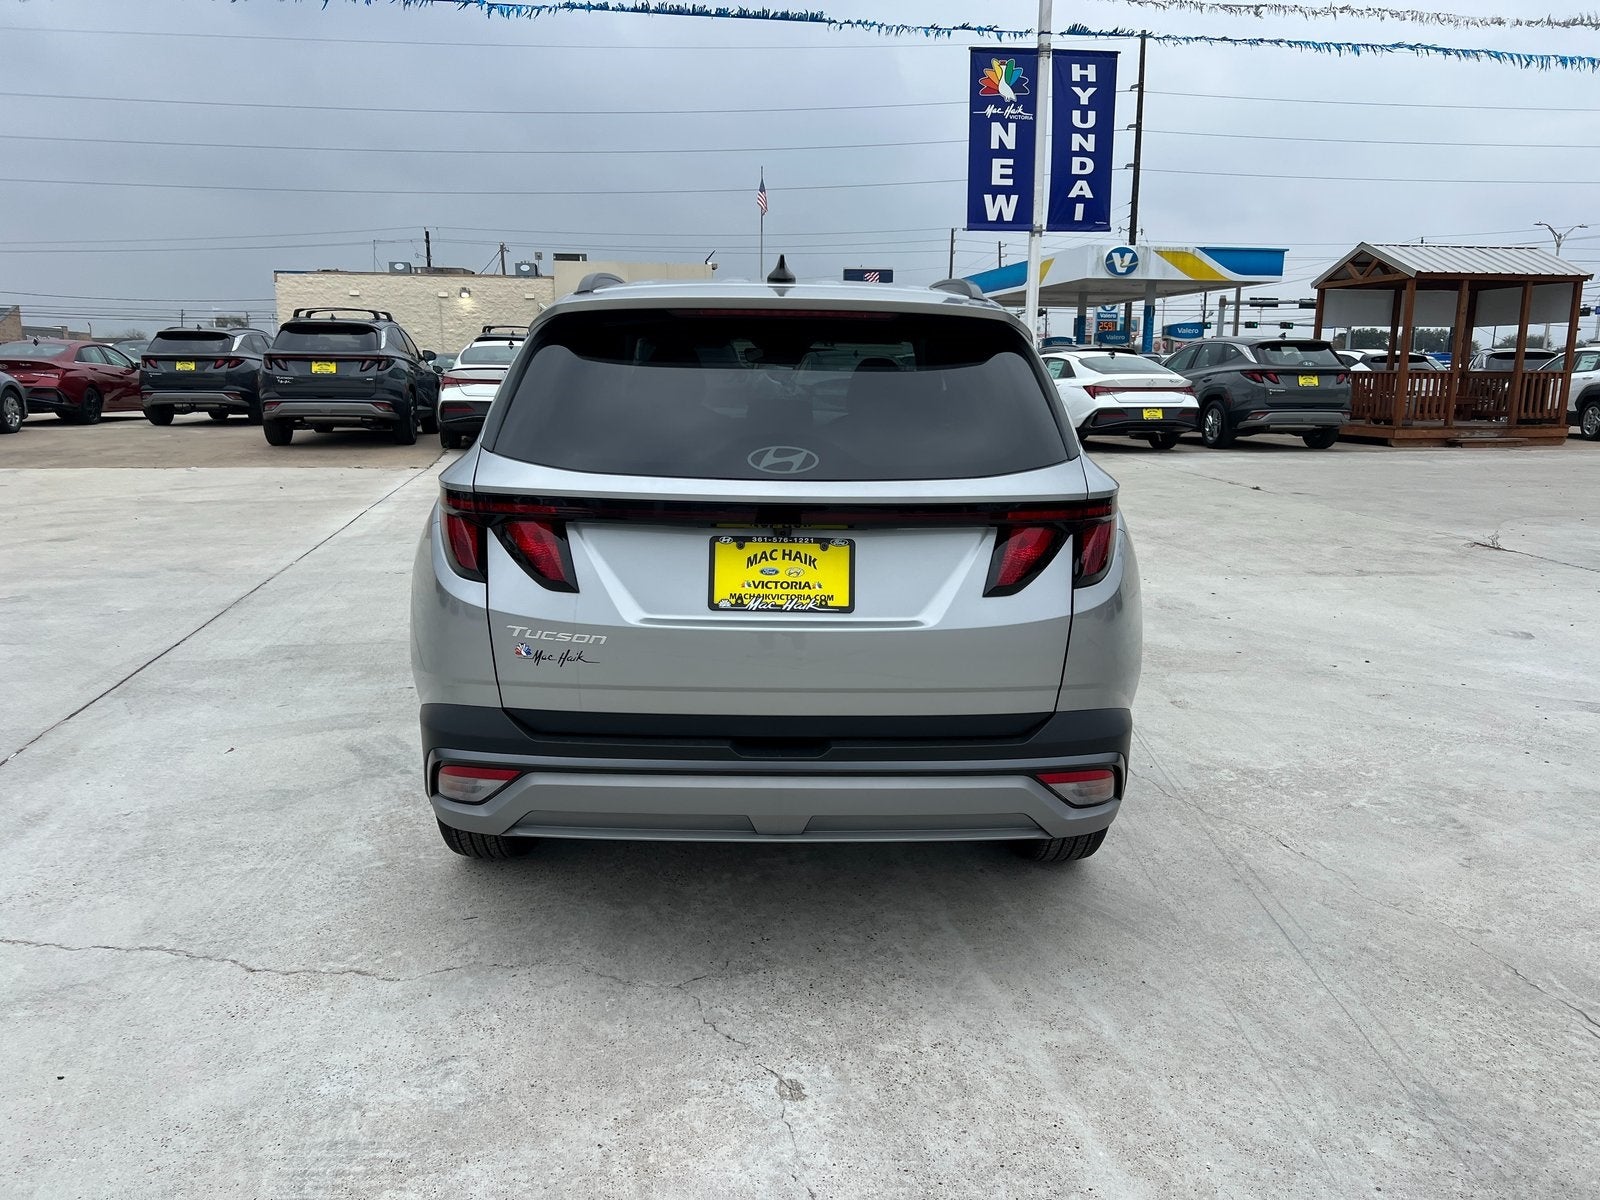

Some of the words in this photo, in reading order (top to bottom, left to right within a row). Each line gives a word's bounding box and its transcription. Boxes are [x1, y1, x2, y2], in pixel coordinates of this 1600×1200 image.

[984, 104, 1003, 118] Mac
[1003, 103, 1029, 119] Haik
[1067, 63, 1098, 221] HYUNDAI
[983, 121, 1019, 222] NEW
[751, 536, 815, 544] 361-576-1221
[746, 548, 778, 569] MAC
[781, 548, 818, 570] HAIK
[751, 580, 812, 590] VICTORIA
[745, 597, 776, 611] Mac
[781, 597, 823, 611] Haik
[532, 650, 555, 667] Mac
[557, 649, 593, 667] Haik
